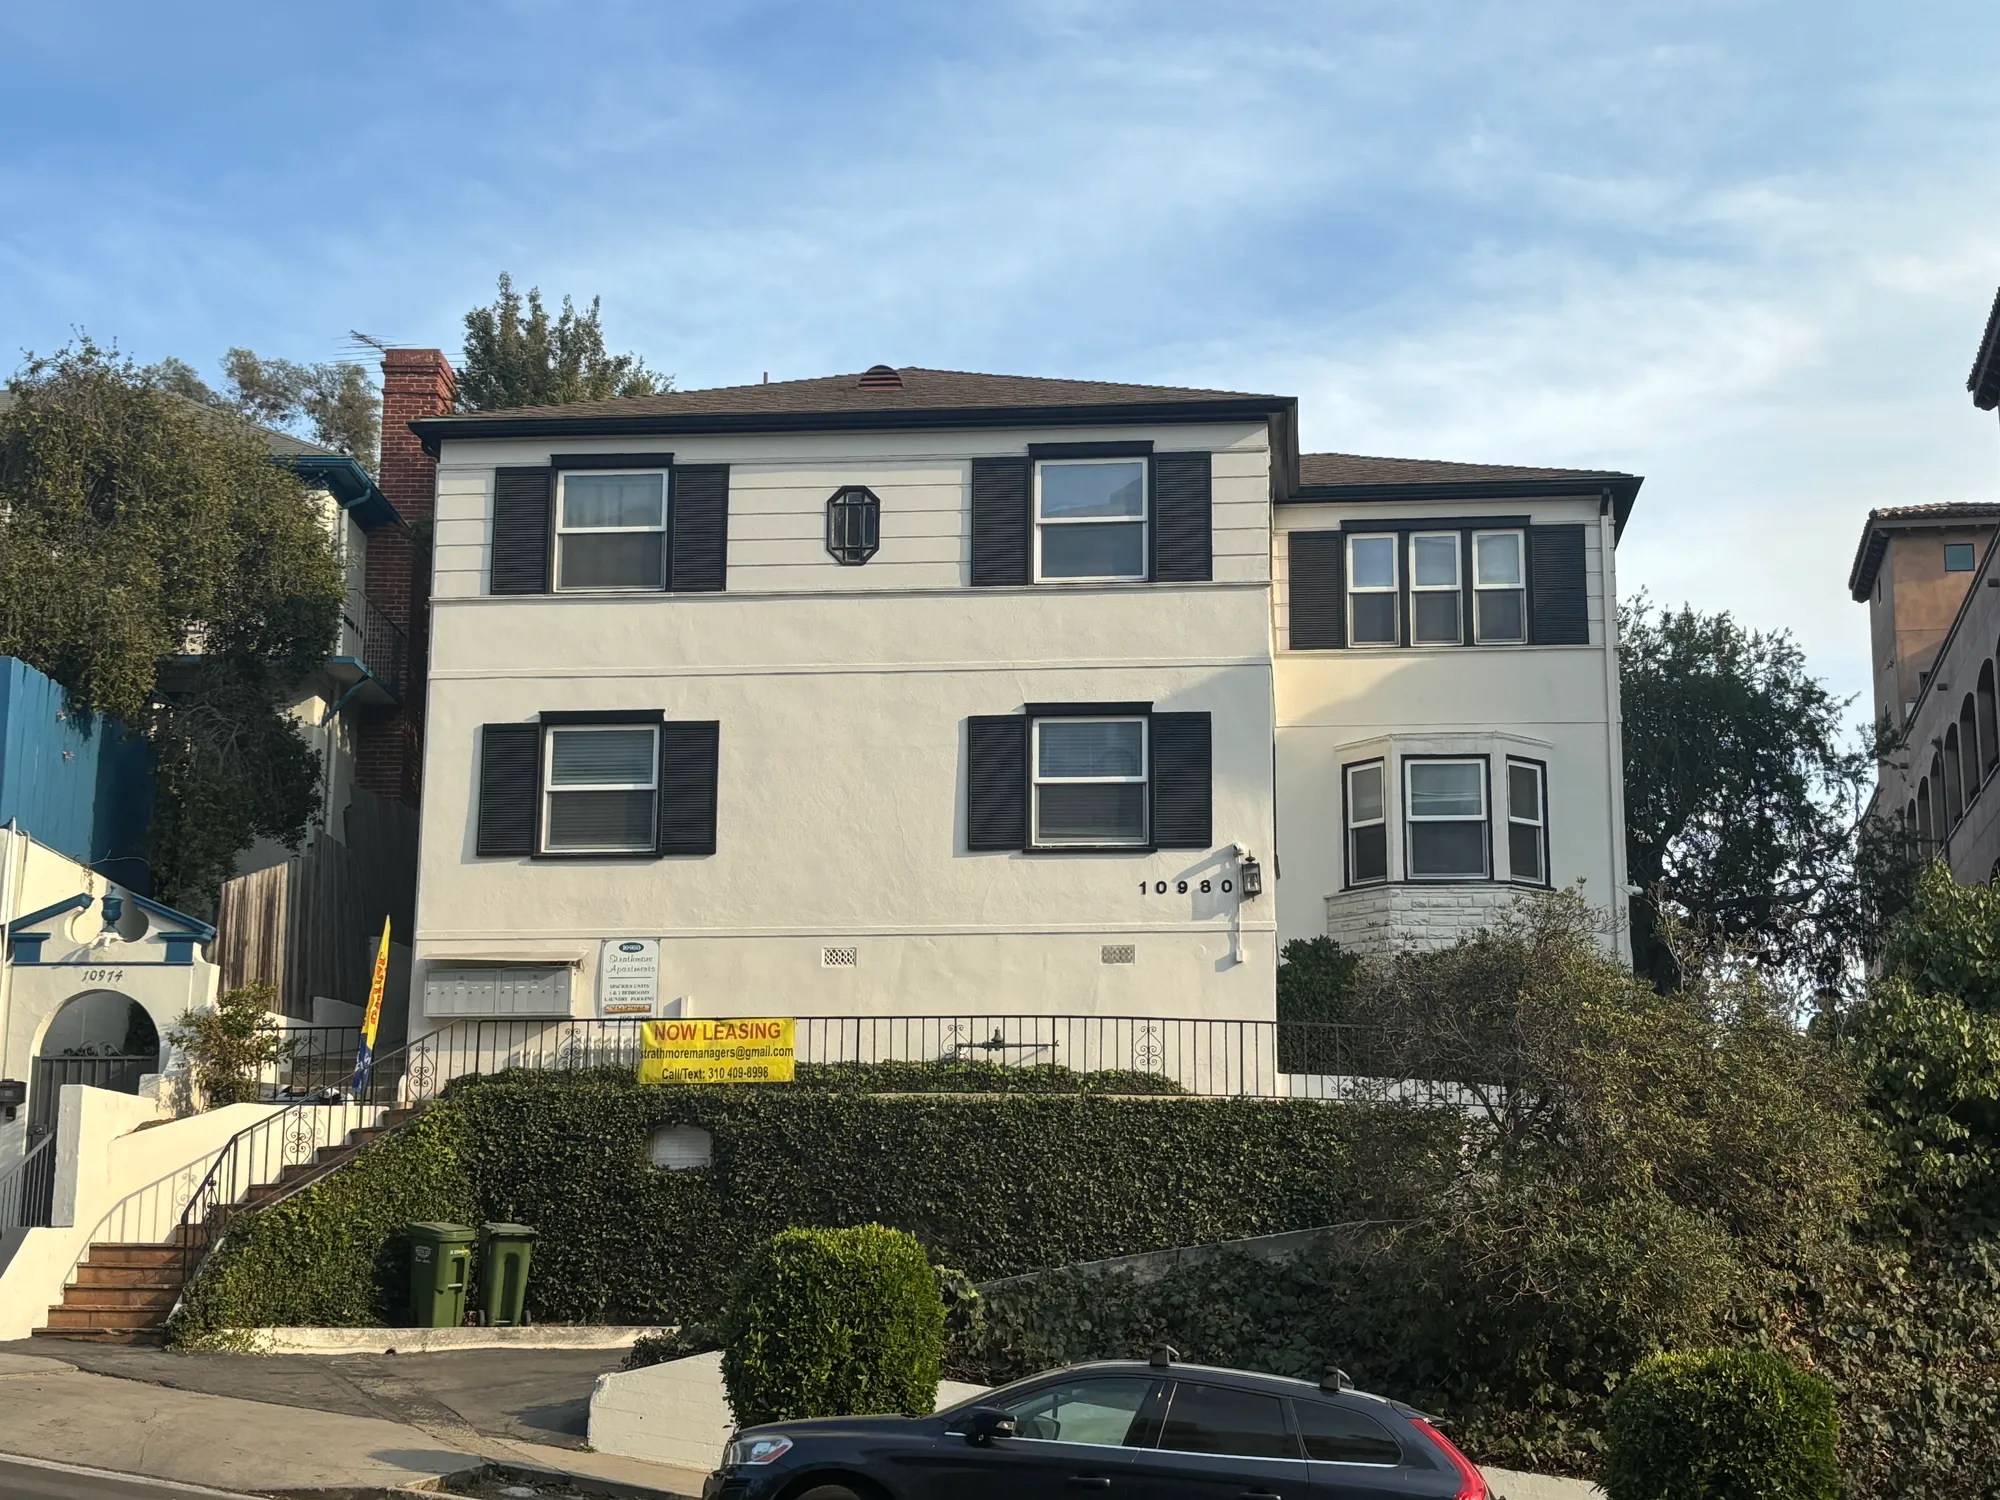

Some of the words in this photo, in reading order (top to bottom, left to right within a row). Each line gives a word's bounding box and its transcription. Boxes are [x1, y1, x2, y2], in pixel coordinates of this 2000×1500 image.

[1138, 879, 1233, 895] 10980
[654, 1024, 697, 1041] NOW
[703, 1022, 781, 1040] LEASING
[640, 1045, 794, 1061] strathmoremanagers@gmail.com
[661, 1068, 706, 1080] Call/Text:
[708, 1067, 725, 1079] 310
